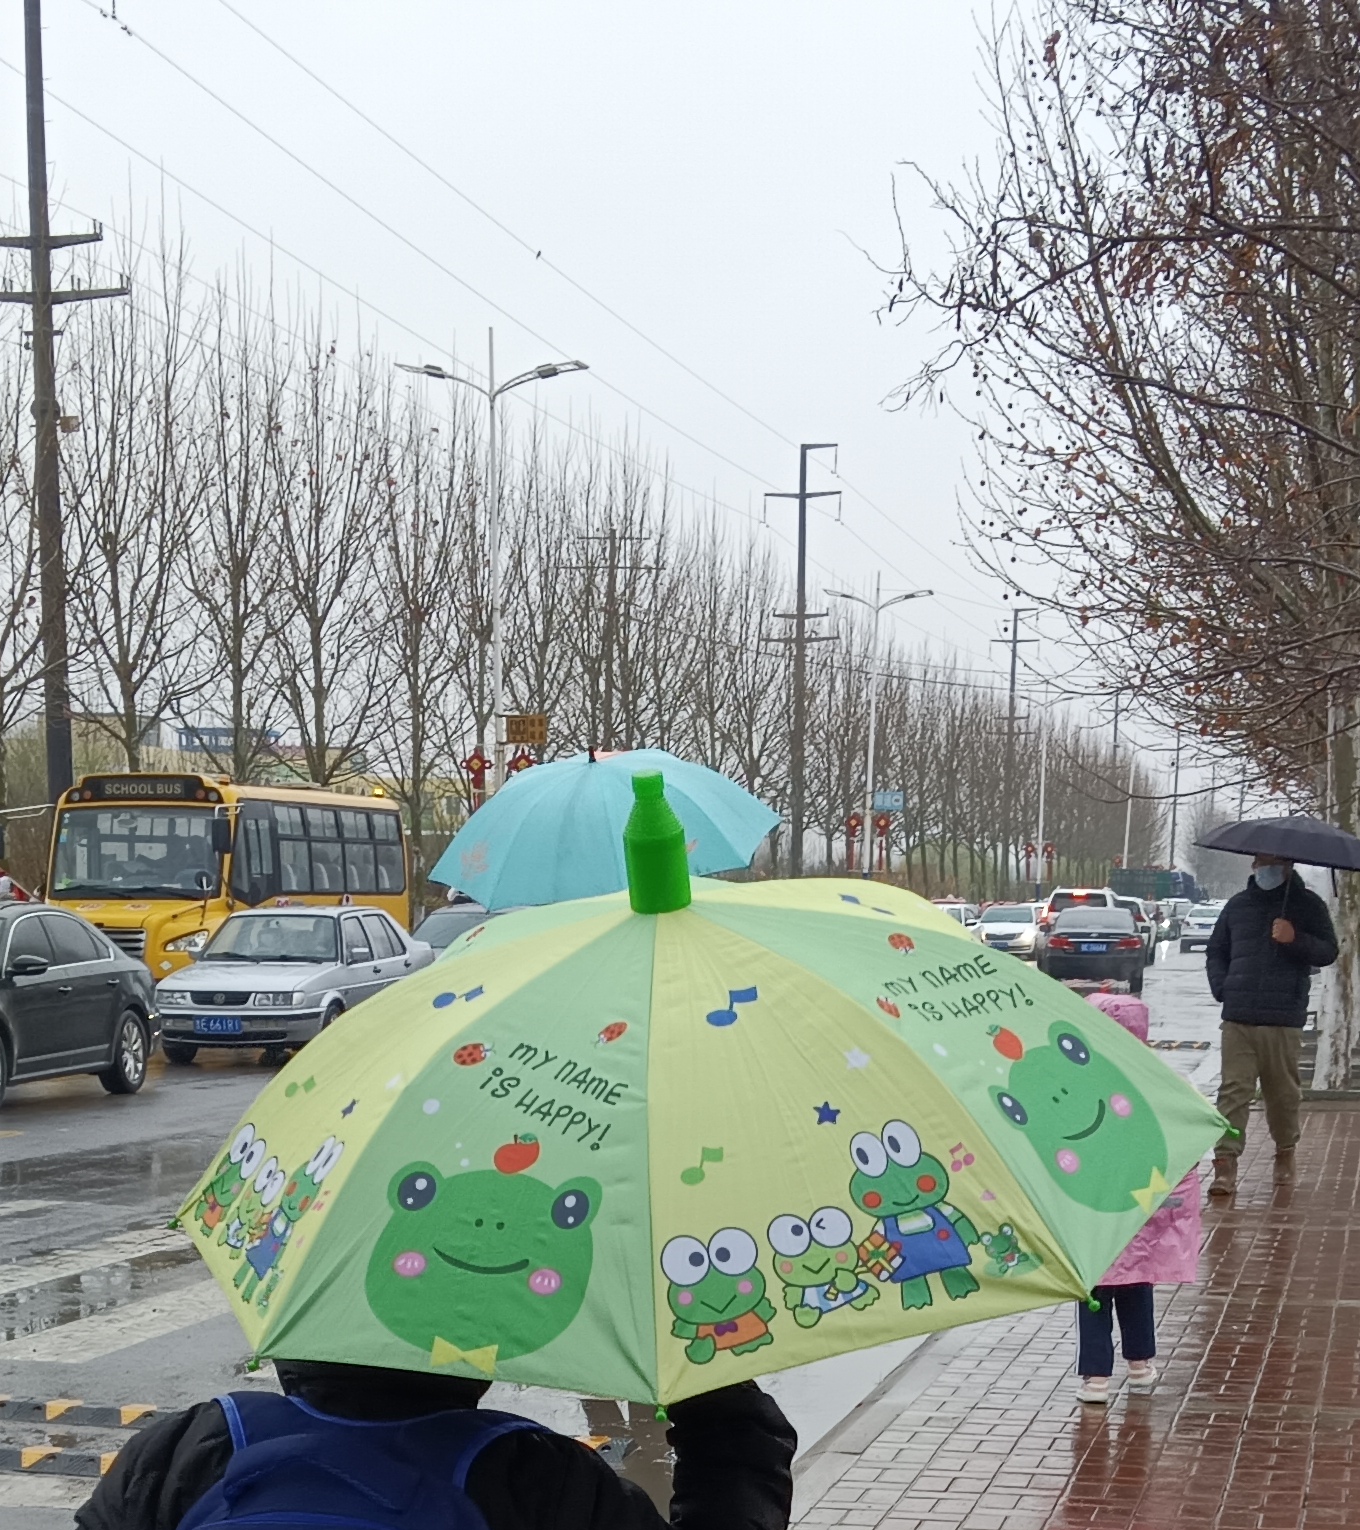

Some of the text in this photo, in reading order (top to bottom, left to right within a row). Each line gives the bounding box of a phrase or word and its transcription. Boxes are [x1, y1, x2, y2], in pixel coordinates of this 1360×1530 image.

[104, 783, 181, 795] SCHOOL BUS
[941, 983, 1034, 1019] HAPPY!
[514, 1088, 612, 1152] HAPPY!
